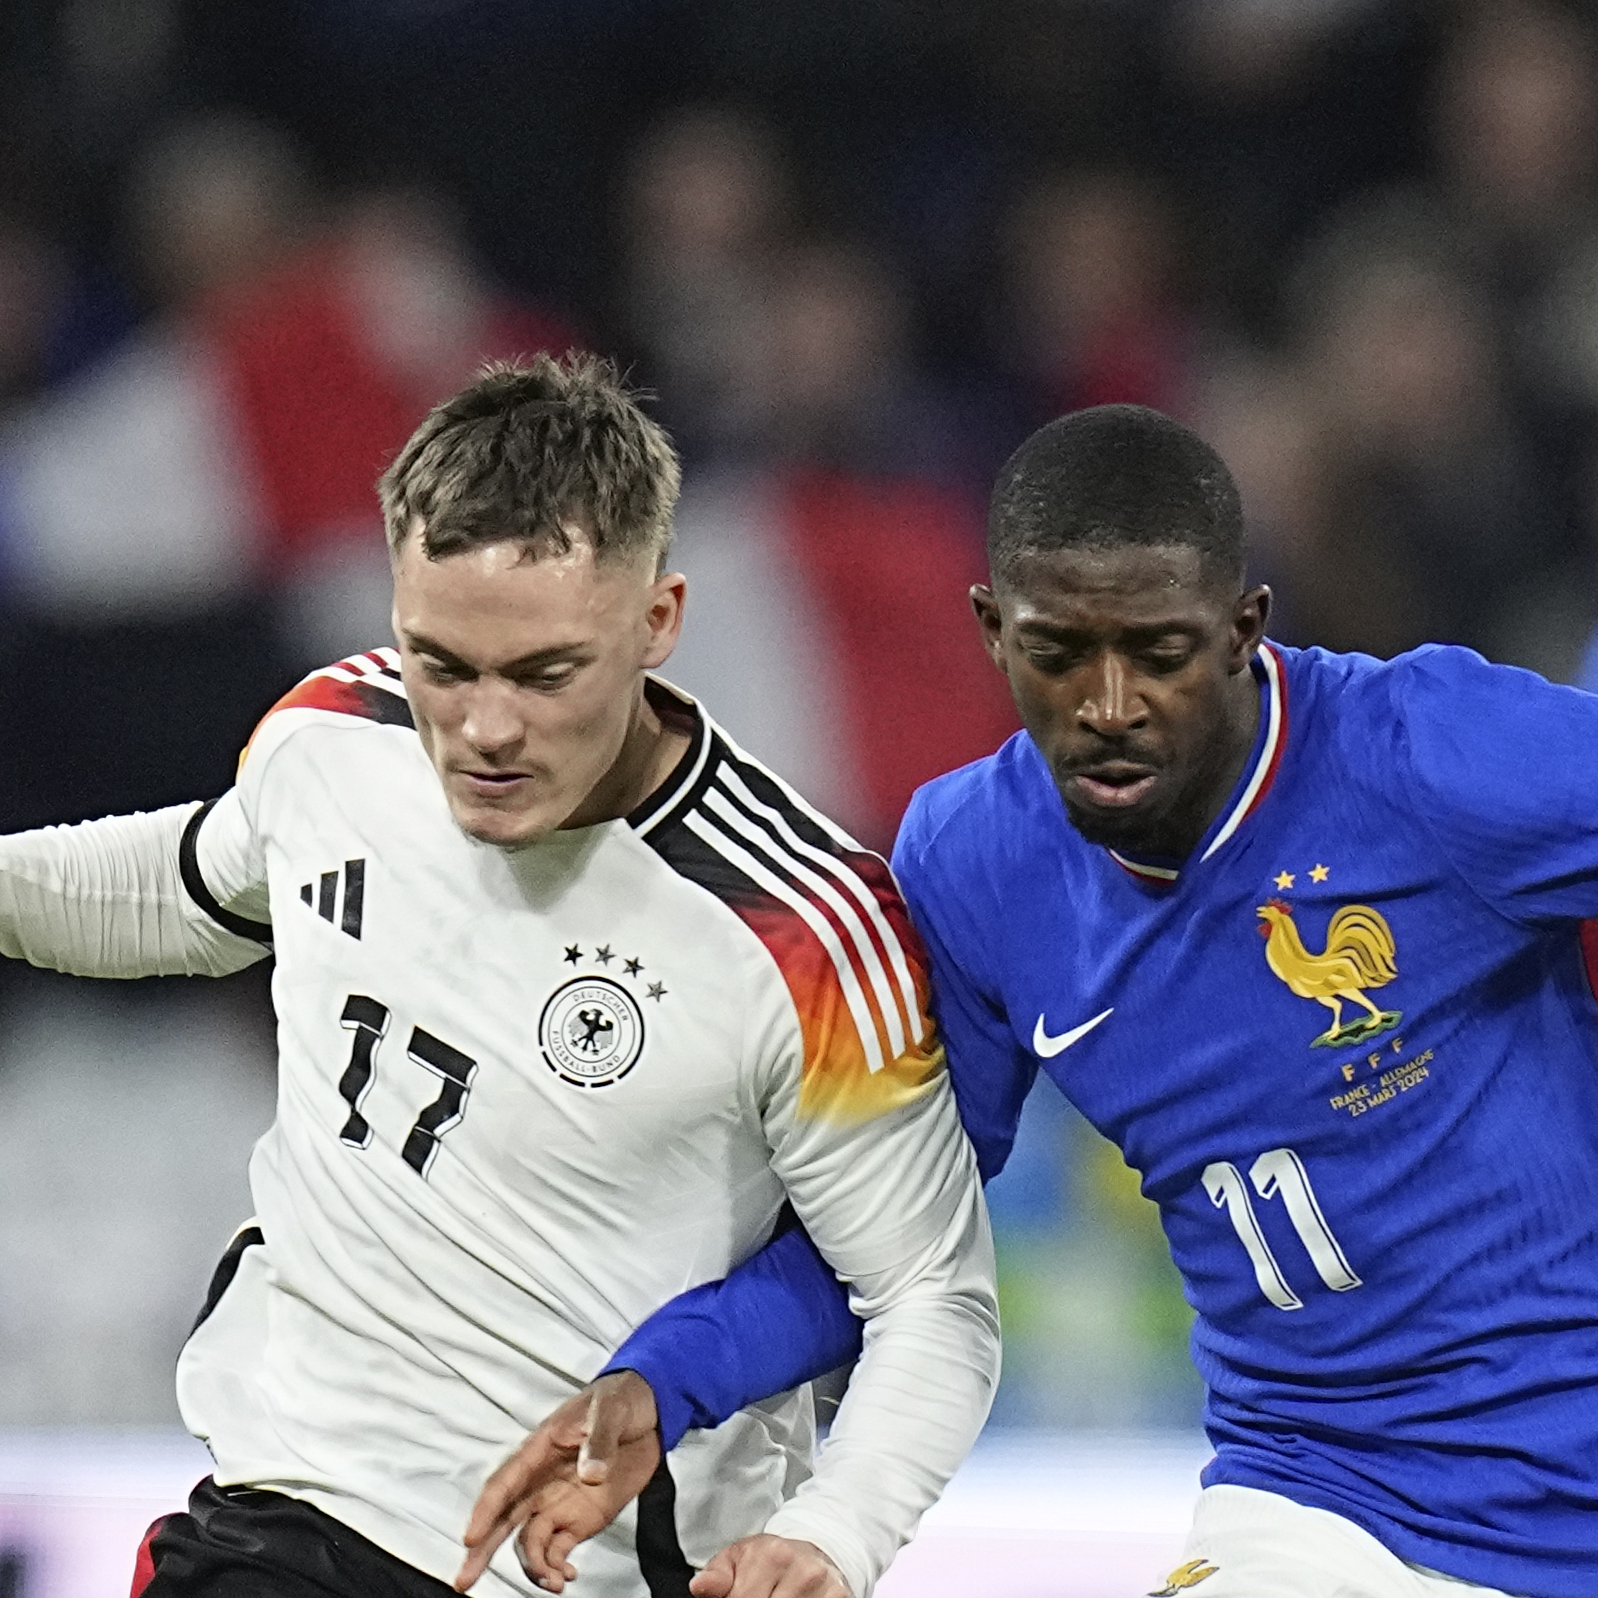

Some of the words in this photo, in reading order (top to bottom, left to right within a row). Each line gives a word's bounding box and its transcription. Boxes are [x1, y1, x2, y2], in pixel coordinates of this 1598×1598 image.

[572, 990, 630, 1022] DEUTSCHER
[339, 994, 479, 1182] 17
[1329, 1084, 1371, 1111] FRANCE
[1379, 1048, 1434, 1088] ALLEMAGNE
[1348, 1101, 1367, 1117] 23
[1366, 1084, 1397, 1108] MARS
[1397, 1066, 1430, 1093] 2024
[1200, 1147, 1364, 1312] 11
